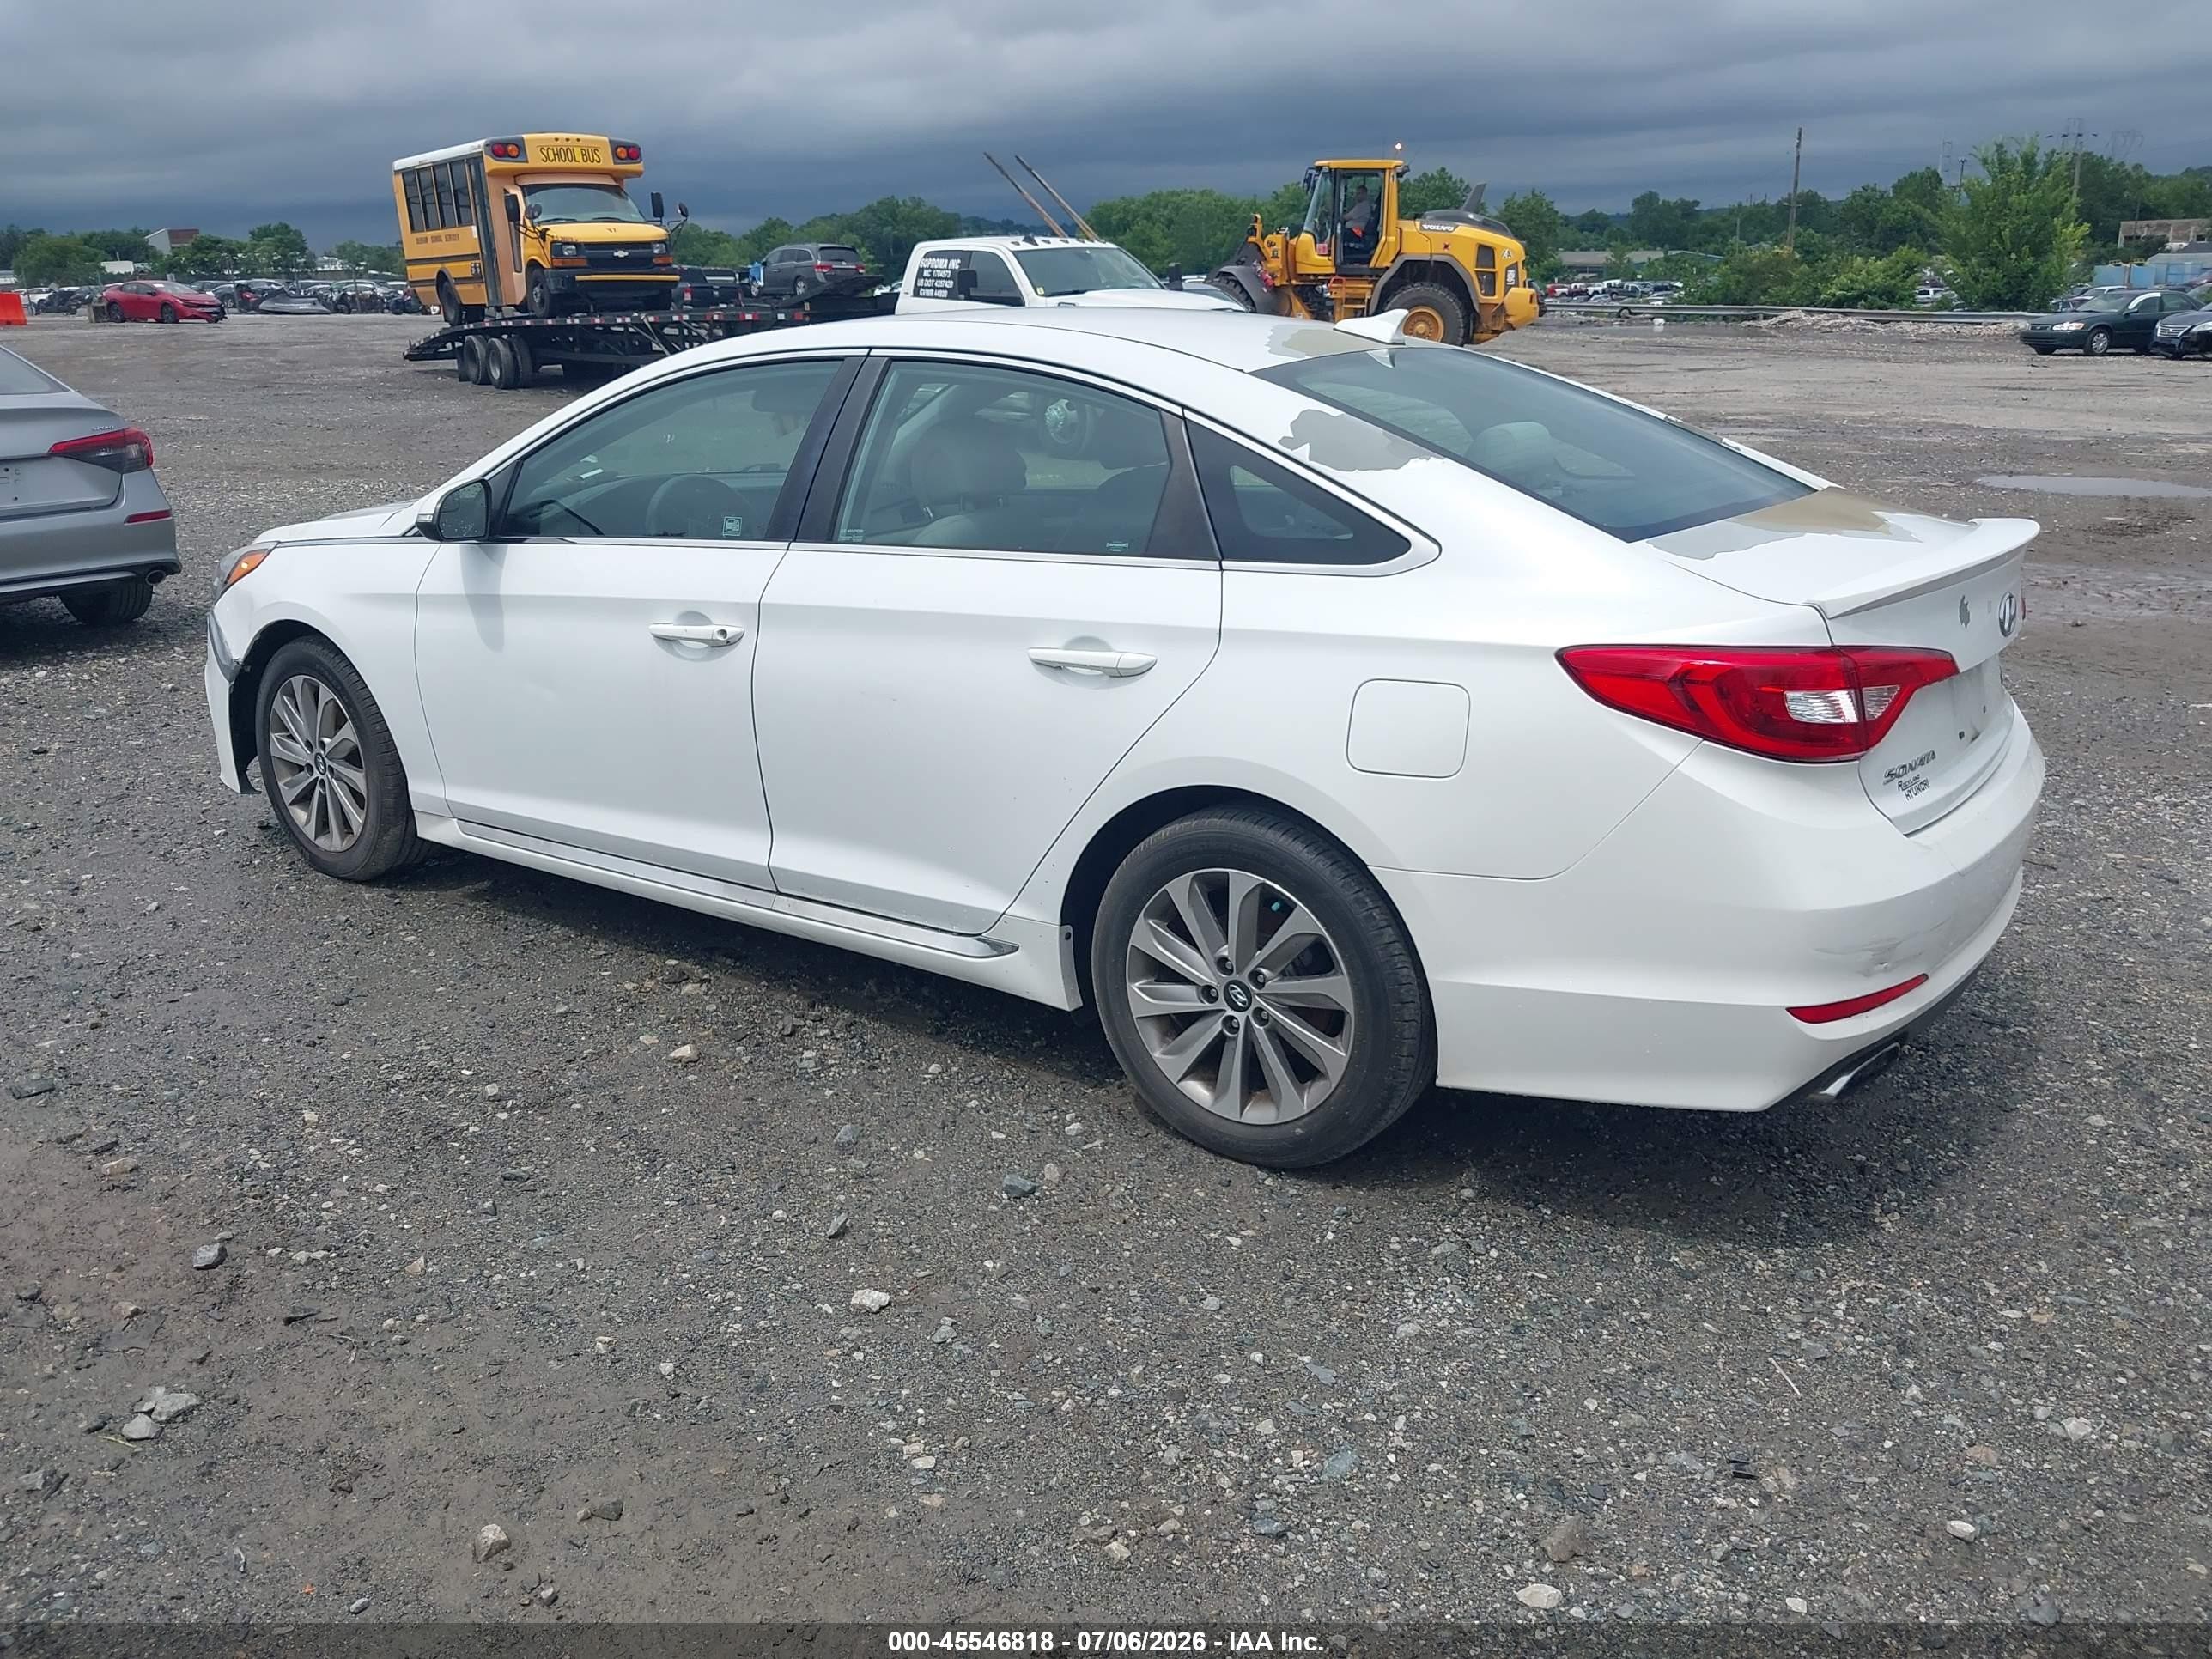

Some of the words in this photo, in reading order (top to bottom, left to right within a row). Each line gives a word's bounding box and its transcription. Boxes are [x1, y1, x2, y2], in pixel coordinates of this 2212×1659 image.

[539, 147, 580, 163] SCHOOL
[580, 148, 602, 164] BUS
[920, 258, 949, 269] SOPROMA
[949, 258, 961, 270] INC
[925, 279, 934, 288] DOT
[1883, 750, 1936, 786] SONATA
[1904, 778, 1931, 801] HYUNDAI
